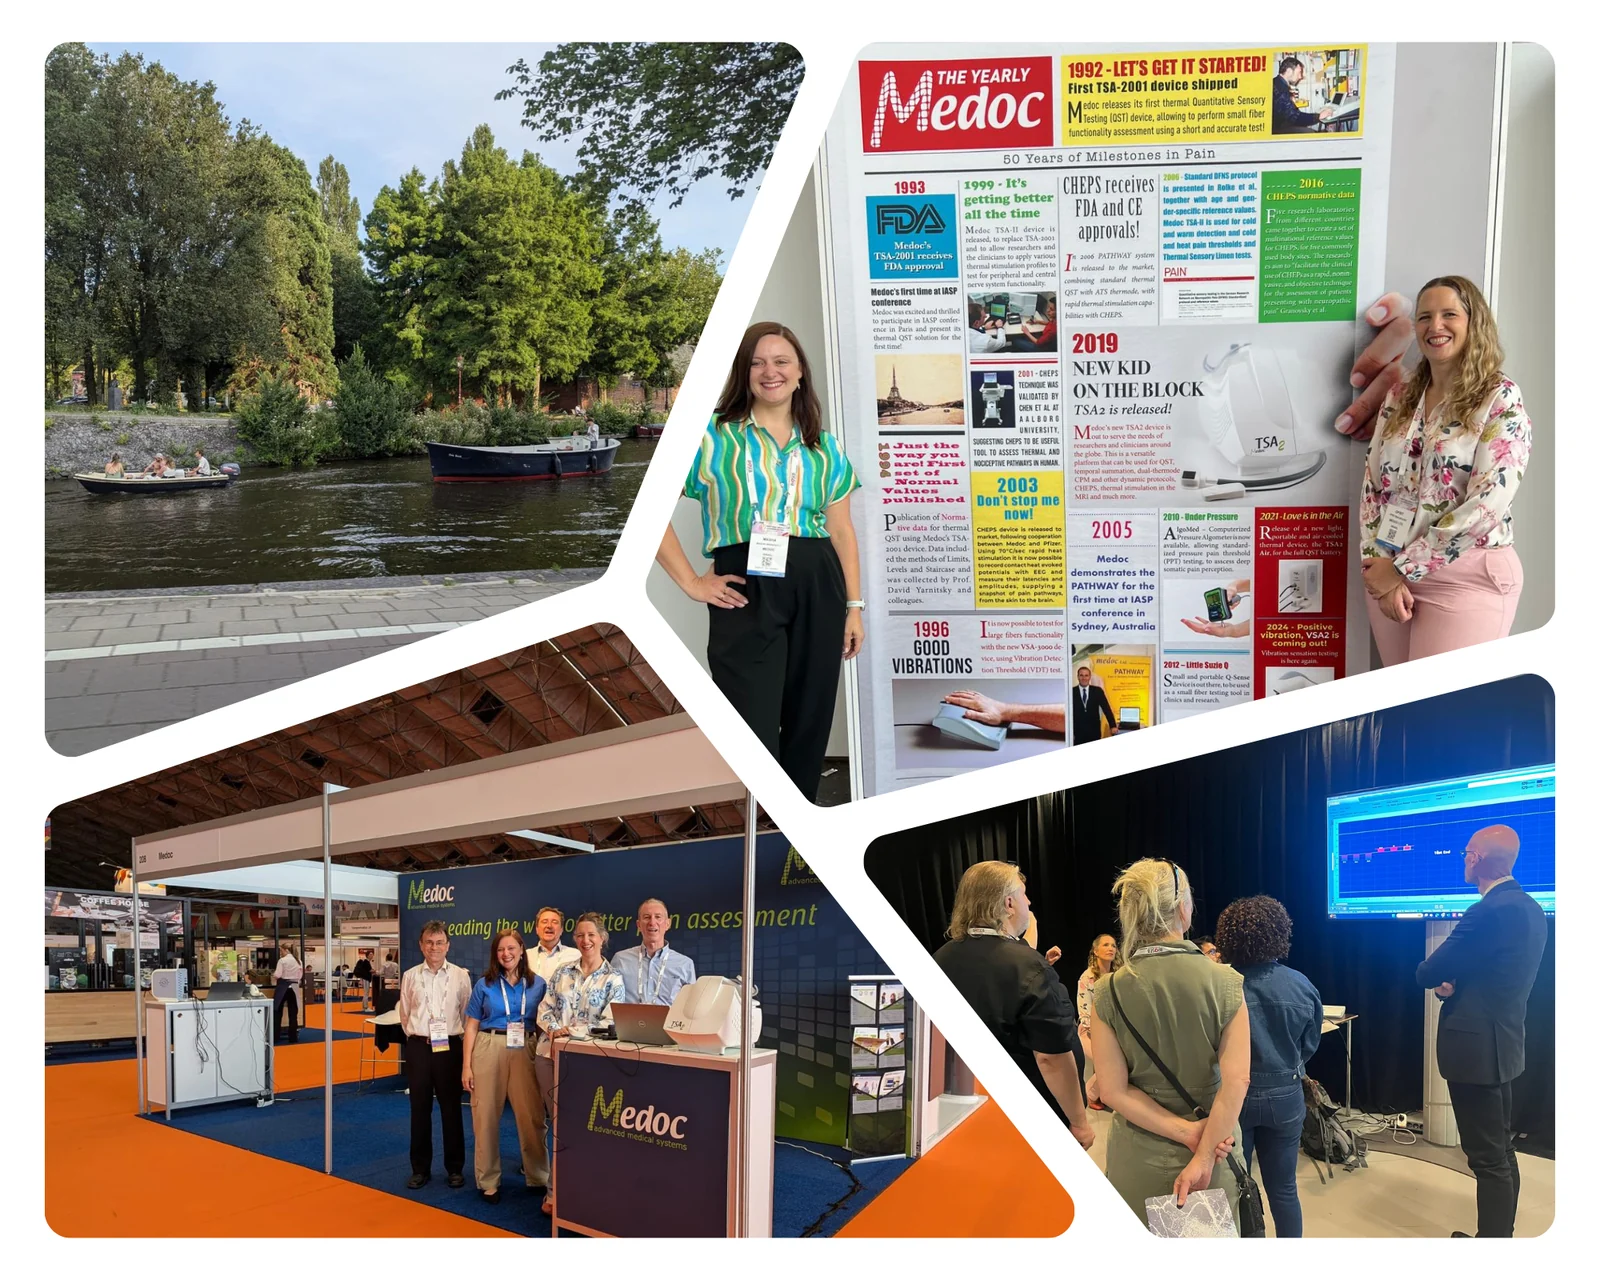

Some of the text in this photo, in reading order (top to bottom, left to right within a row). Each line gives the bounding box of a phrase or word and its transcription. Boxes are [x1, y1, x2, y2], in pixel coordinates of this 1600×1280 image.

[1068, 56, 1267, 78] 1992 LET'S GET IT STARTED!
[938, 67, 1031, 85] THE YEARLY
[1068, 78, 1238, 94] First TSA-2001 device shipped
[1102, 98, 1131, 109] releases
[1133, 98, 1143, 108] its
[1145, 98, 1160, 107] first
[1162, 97, 1190, 107] thermal
[1192, 96, 1235, 107] Quantitative
[1237, 95, 1266, 108] Sensory
[870, 70, 1045, 148] Medoc
[1083, 109, 1265, 125] Testing (QST) device, allowing perform small fiber
[1068, 123, 1265, 138] functionality assessment using short and accurate test!
[1003, 148, 1216, 165] 50 Years of Milestones in Pain
[894, 181, 925, 194] 1993
[964, 178, 1027, 191] 1999 It's
[1063, 175, 1155, 195] CHEPS receives
[1299, 179, 1324, 188] 2016
[964, 193, 1054, 207] getting better
[1298, 192, 1337, 200] normative
[965, 208, 1041, 220] all the time
[1075, 198, 1143, 217] FDA and CE
[876, 204, 946, 235] FDA
[1078, 220, 1140, 242] approvals!
[894, 241, 932, 250] Medoc's
[874, 252, 954, 260] TSA-2001 receives
[884, 262, 944, 272] FDA approval
[1164, 267, 1187, 277] PAIN
[871, 288, 900, 296] Medoc's
[901, 287, 916, 296] first
[942, 287, 957, 295] IASP
[871, 298, 912, 307] conference
[1072, 333, 1119, 354] 2019
[1073, 360, 1151, 376] NEW KID
[1074, 381, 1205, 399] ON THE BLOCK
[1074, 403, 1172, 415] TSA2 is released!
[878, 443, 892, 478] 1994
[997, 478, 1038, 493] 2003
[882, 496, 966, 504] published
[977, 495, 1060, 508] Don't stop me
[1004, 508, 1034, 520] now!
[1260, 512, 1279, 520] 2021
[1283, 512, 1302, 521] Love
[1092, 521, 1132, 538] 2005
[1097, 555, 1129, 563] Medoc
[1071, 569, 1137, 577] demonstrates
[1122, 582, 1136, 590] for
[1139, 582, 1155, 590] the
[1081, 609, 1133, 617] conference
[914, 622, 949, 637] 1996
[1072, 623, 1109, 631] Sydney,
[1260, 632, 1303, 640] vibration,
[914, 640, 950, 655] GOOD
[1272, 640, 1306, 648] coming
[892, 658, 973, 674] VIBRATIONS
[1205, 661, 1223, 669] Suzie
[158, 851, 174, 860] Medoc
[407, 879, 455, 910] Medoc
[80, 896, 150, 908] COFFEE HOSE
[443, 919, 492, 940] eading
[687, 904, 818, 929] assesment
[587, 1086, 687, 1139] Medoc
[594, 1126, 687, 1150] advanced medical systems
